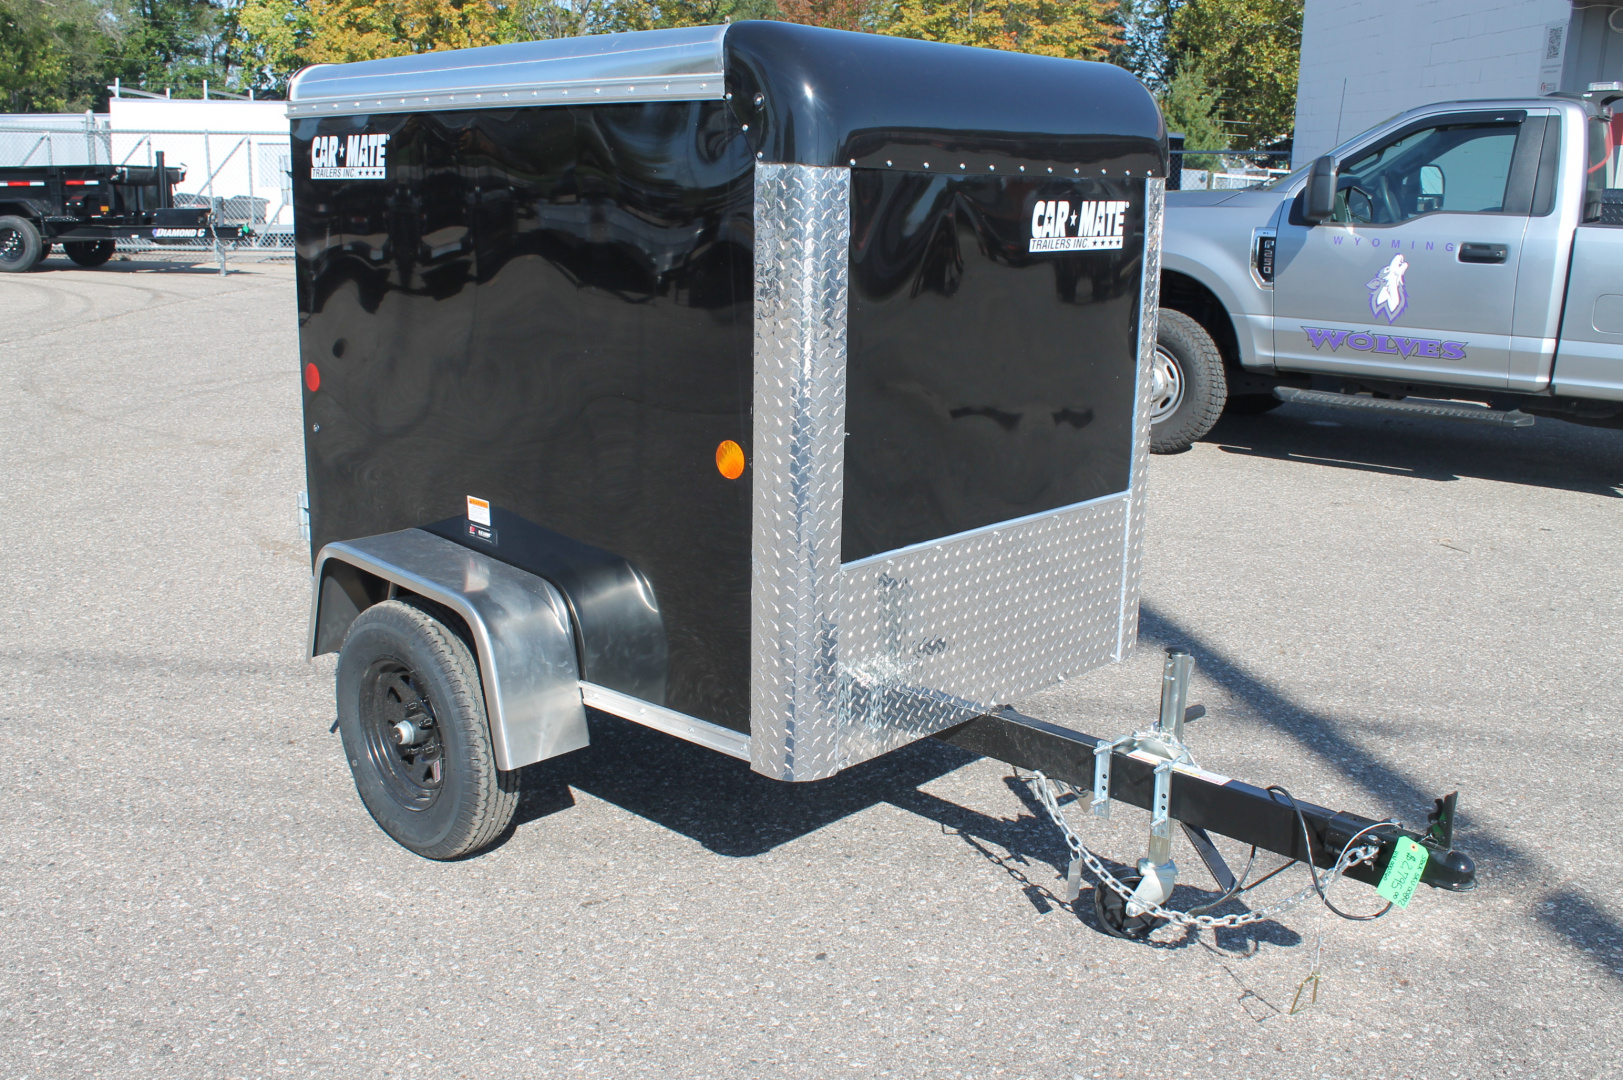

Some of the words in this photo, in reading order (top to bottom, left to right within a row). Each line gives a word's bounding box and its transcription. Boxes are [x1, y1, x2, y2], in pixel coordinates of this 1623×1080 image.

[311, 135, 339, 168] CAR
[346, 133, 387, 167] MATE
[312, 168, 341, 178] TRAILERS
[343, 168, 357, 177] INC.
[1031, 200, 1070, 239] CAR
[1077, 200, 1126, 237] MATE
[156, 228, 197, 238] DIAMOND
[197, 228, 206, 237] C
[1031, 239, 1071, 250] TRAILERS
[1073, 238, 1090, 248] INC.
[1333, 235, 1454, 252] WYOMING
[1300, 325, 1470, 361] WOLVES
